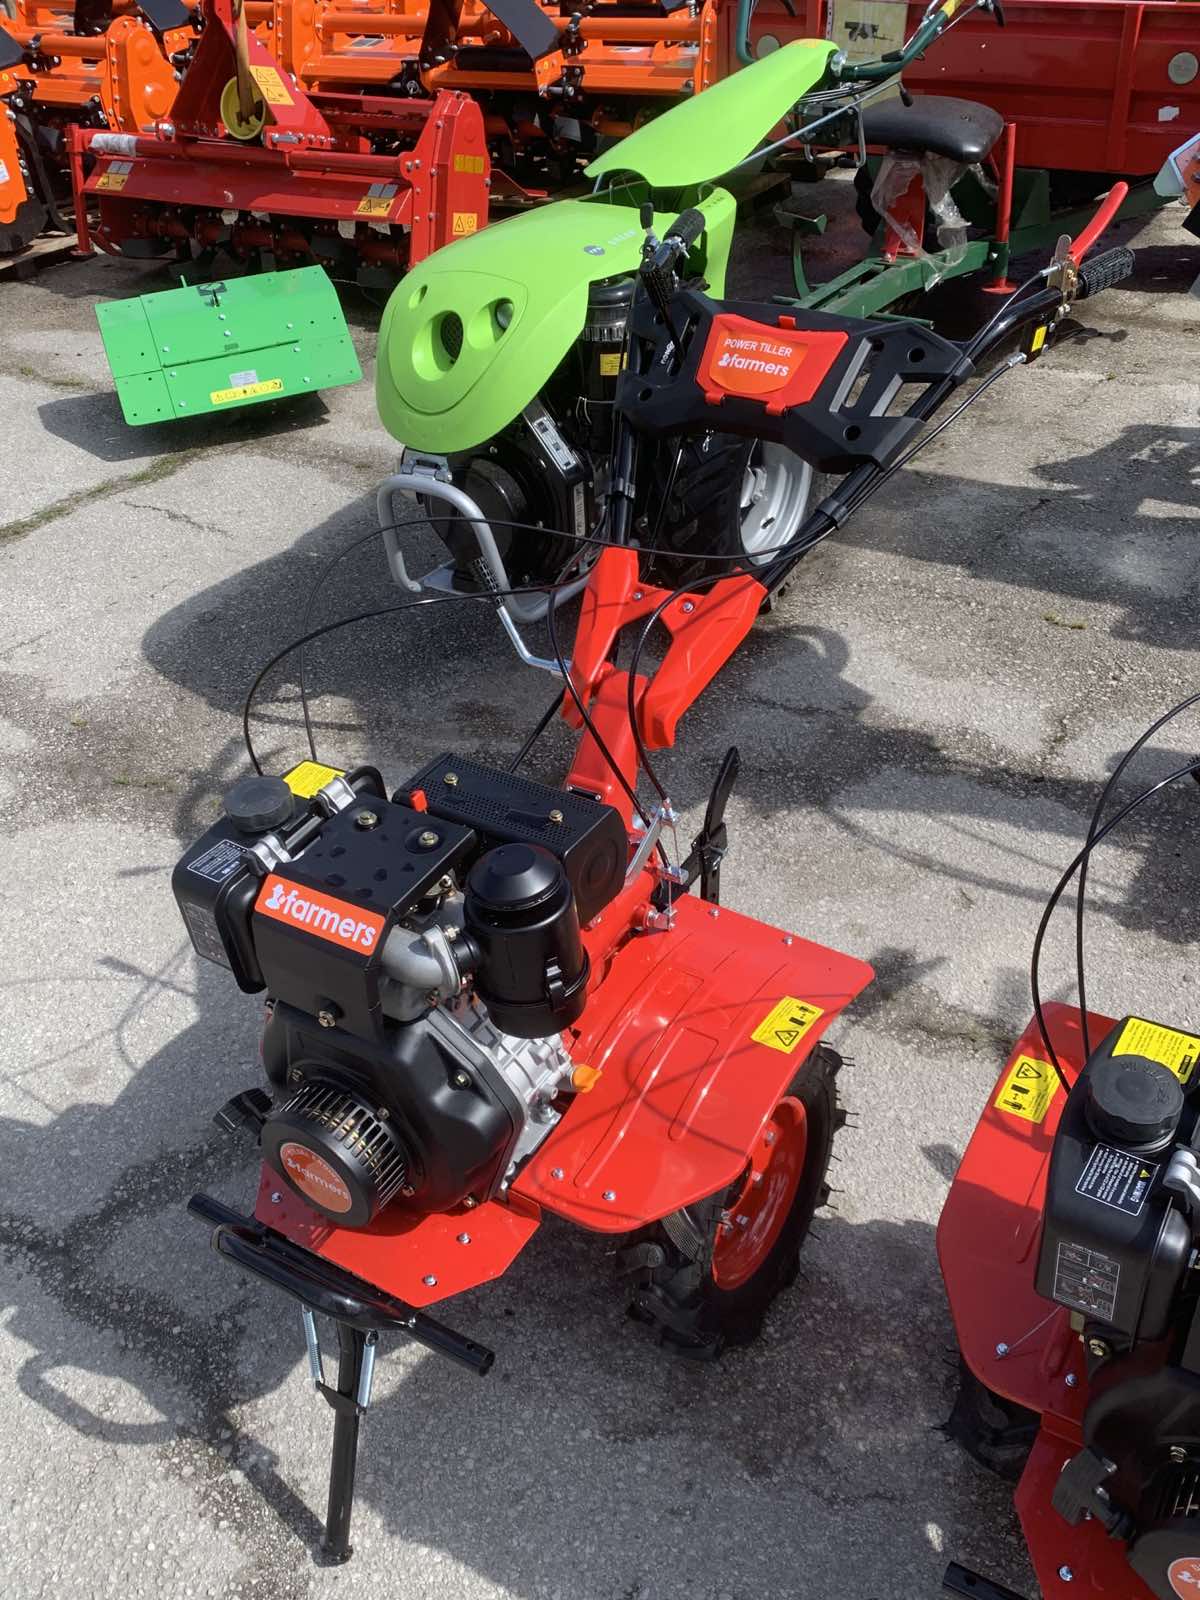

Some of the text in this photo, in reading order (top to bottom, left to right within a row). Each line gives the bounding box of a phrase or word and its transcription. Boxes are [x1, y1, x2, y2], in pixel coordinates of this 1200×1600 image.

[724, 338, 793, 357] POWER TILLER
[729, 353, 790, 377] farmers
[282, 889, 376, 947] farmers
